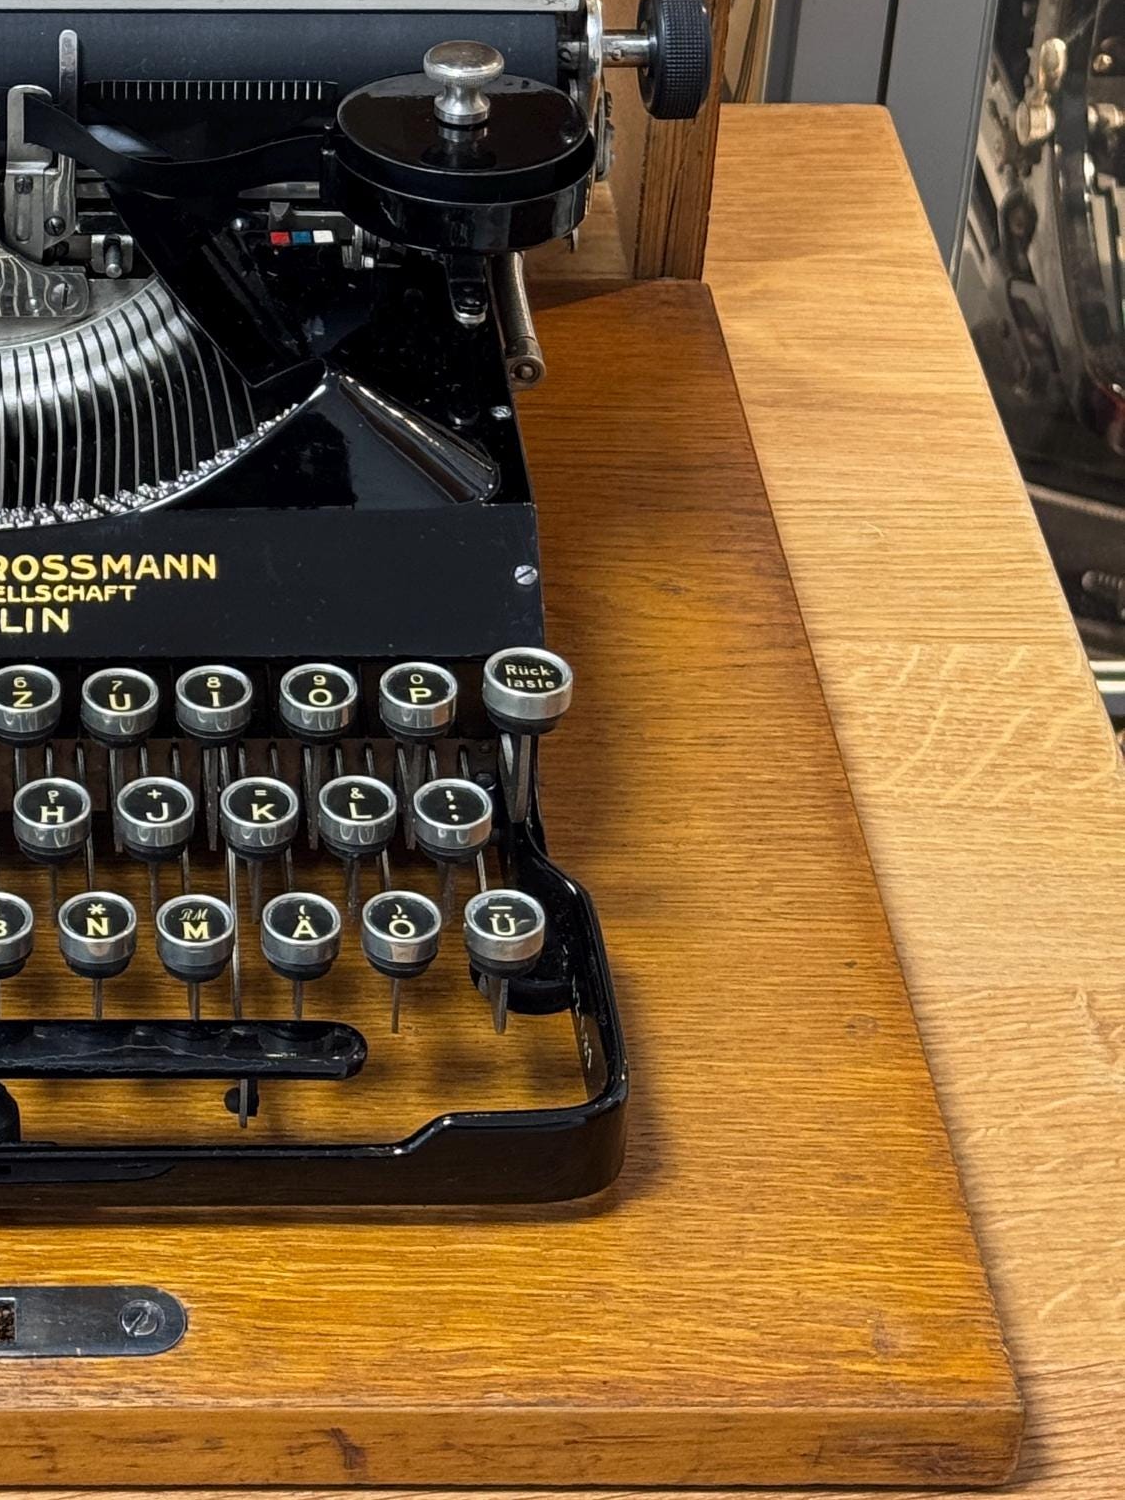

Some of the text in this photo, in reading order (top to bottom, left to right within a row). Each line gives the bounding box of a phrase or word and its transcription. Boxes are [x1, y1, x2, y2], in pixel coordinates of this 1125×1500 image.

[13, 676, 28, 689] 6
[111, 680, 123, 692] 7
[206, 676, 222, 689] 8
[313, 674, 327, 686] 9
[12, 690, 33, 708] Z
[108, 693, 132, 711] U
[308, 688, 333, 706] O
[409, 688, 432, 703] P
[47, 790, 60, 804] ?
[147, 789, 162, 799] +
[254, 789, 268, 797] =
[350, 787, 365, 800] &
[40, 805, 65, 823] H
[145, 802, 169, 822] J
[251, 803, 277, 821] K
[349, 802, 373, 820] L
[86, 917, 109, 936] N
[182, 921, 210, 940] M
[292, 915, 318, 938] Ä
[388, 914, 416, 938] Ö
[490, 913, 517, 937] Ü
